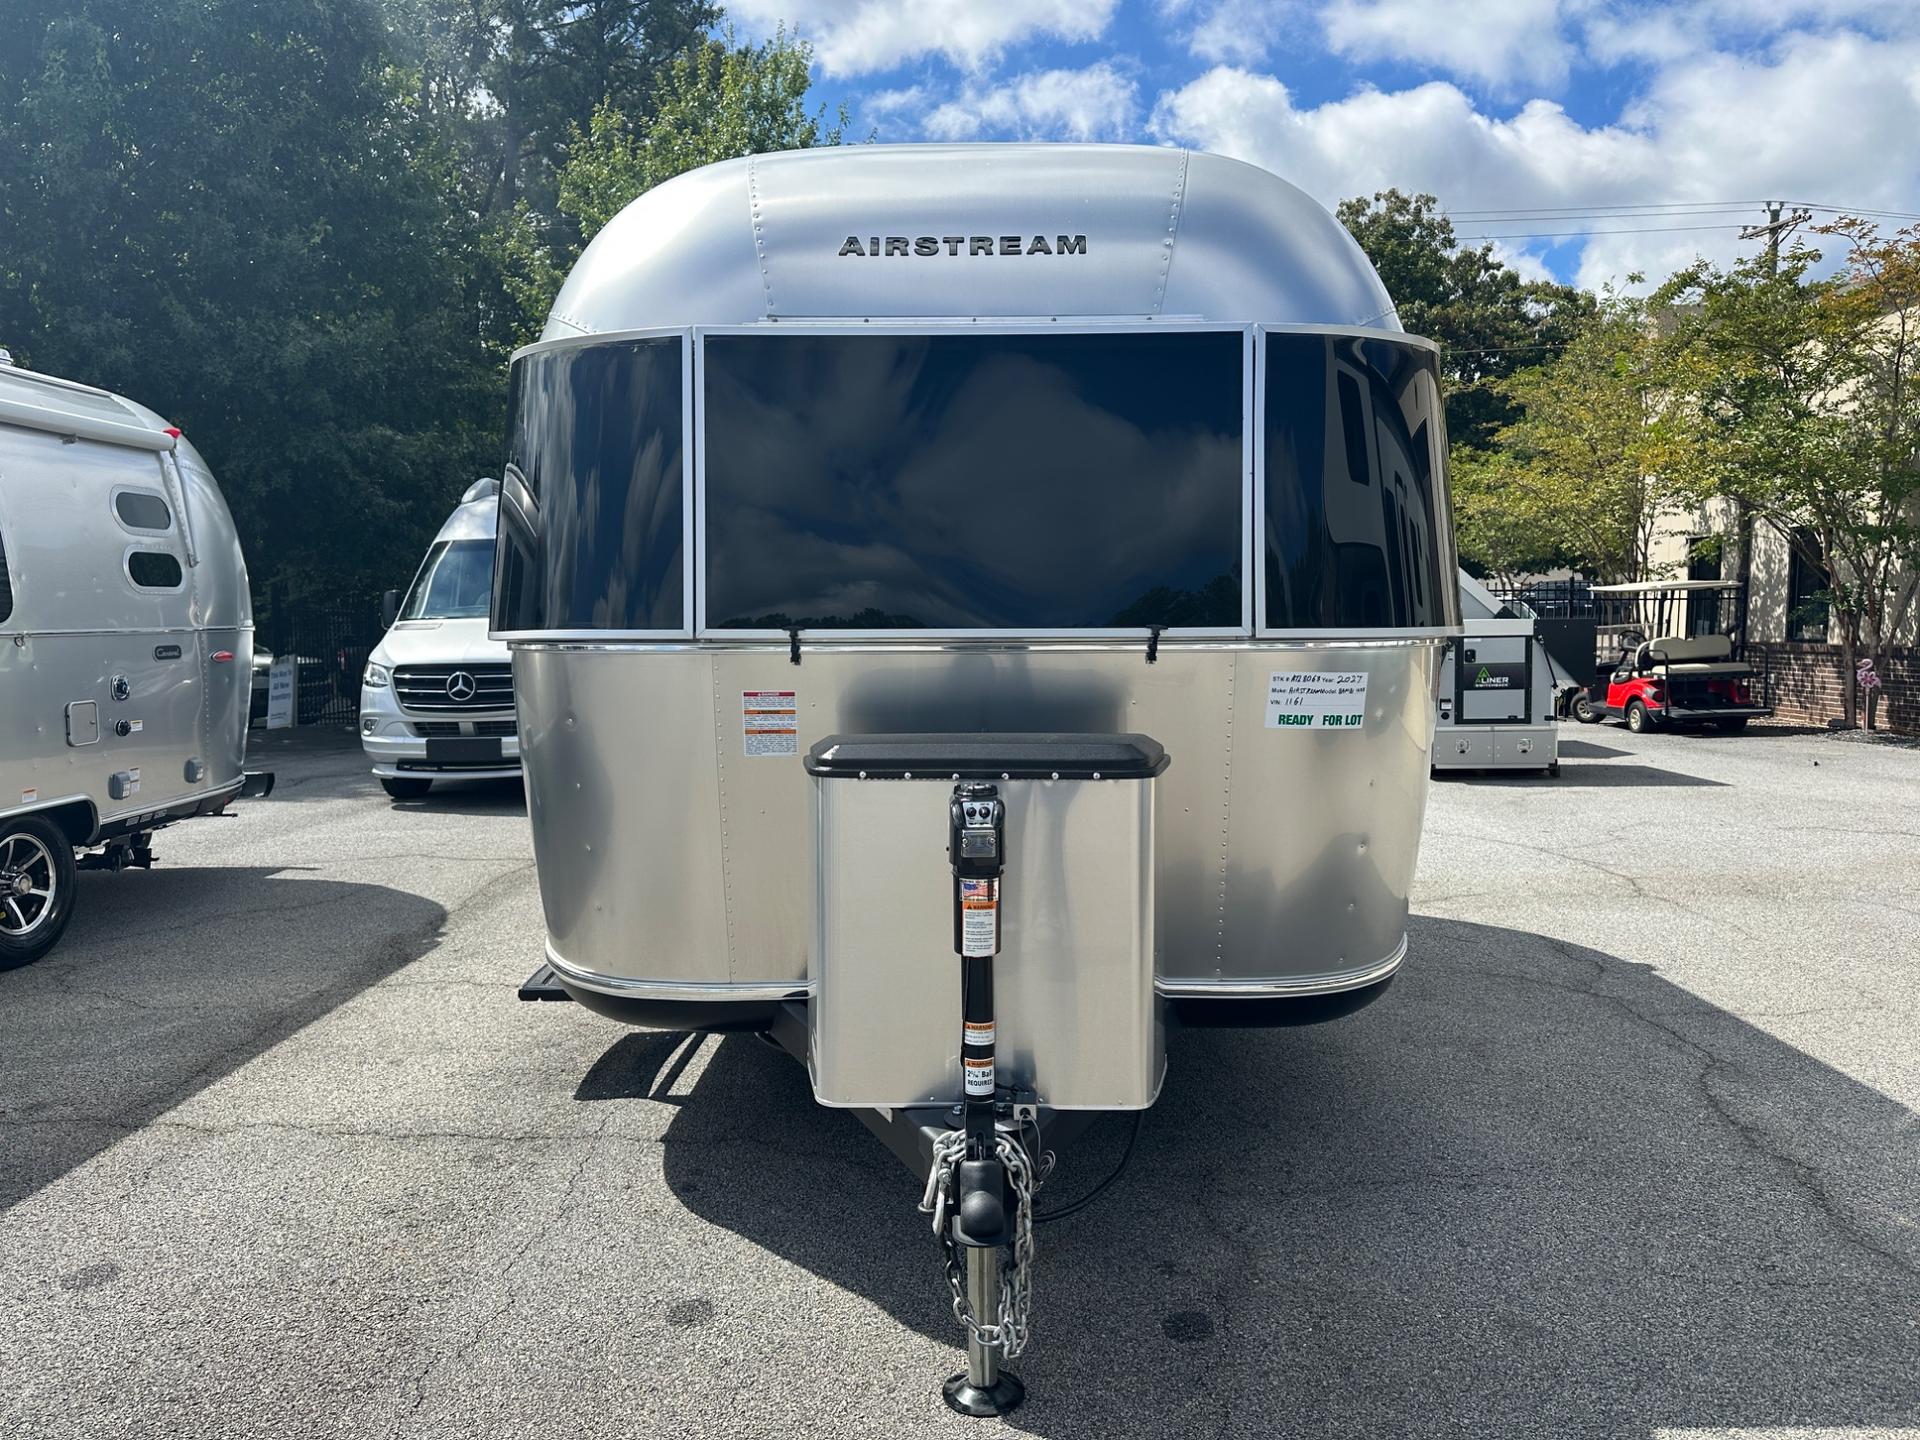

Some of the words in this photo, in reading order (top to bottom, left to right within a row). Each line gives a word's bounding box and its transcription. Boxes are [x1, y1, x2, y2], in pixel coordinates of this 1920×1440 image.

[838, 235, 1087, 257] AIRSTREAM
[1337, 675, 1363, 684] 2027
[1278, 714, 1314, 725] READY
[1322, 714, 1342, 725] FOR
[1345, 714, 1363, 725] LOT
